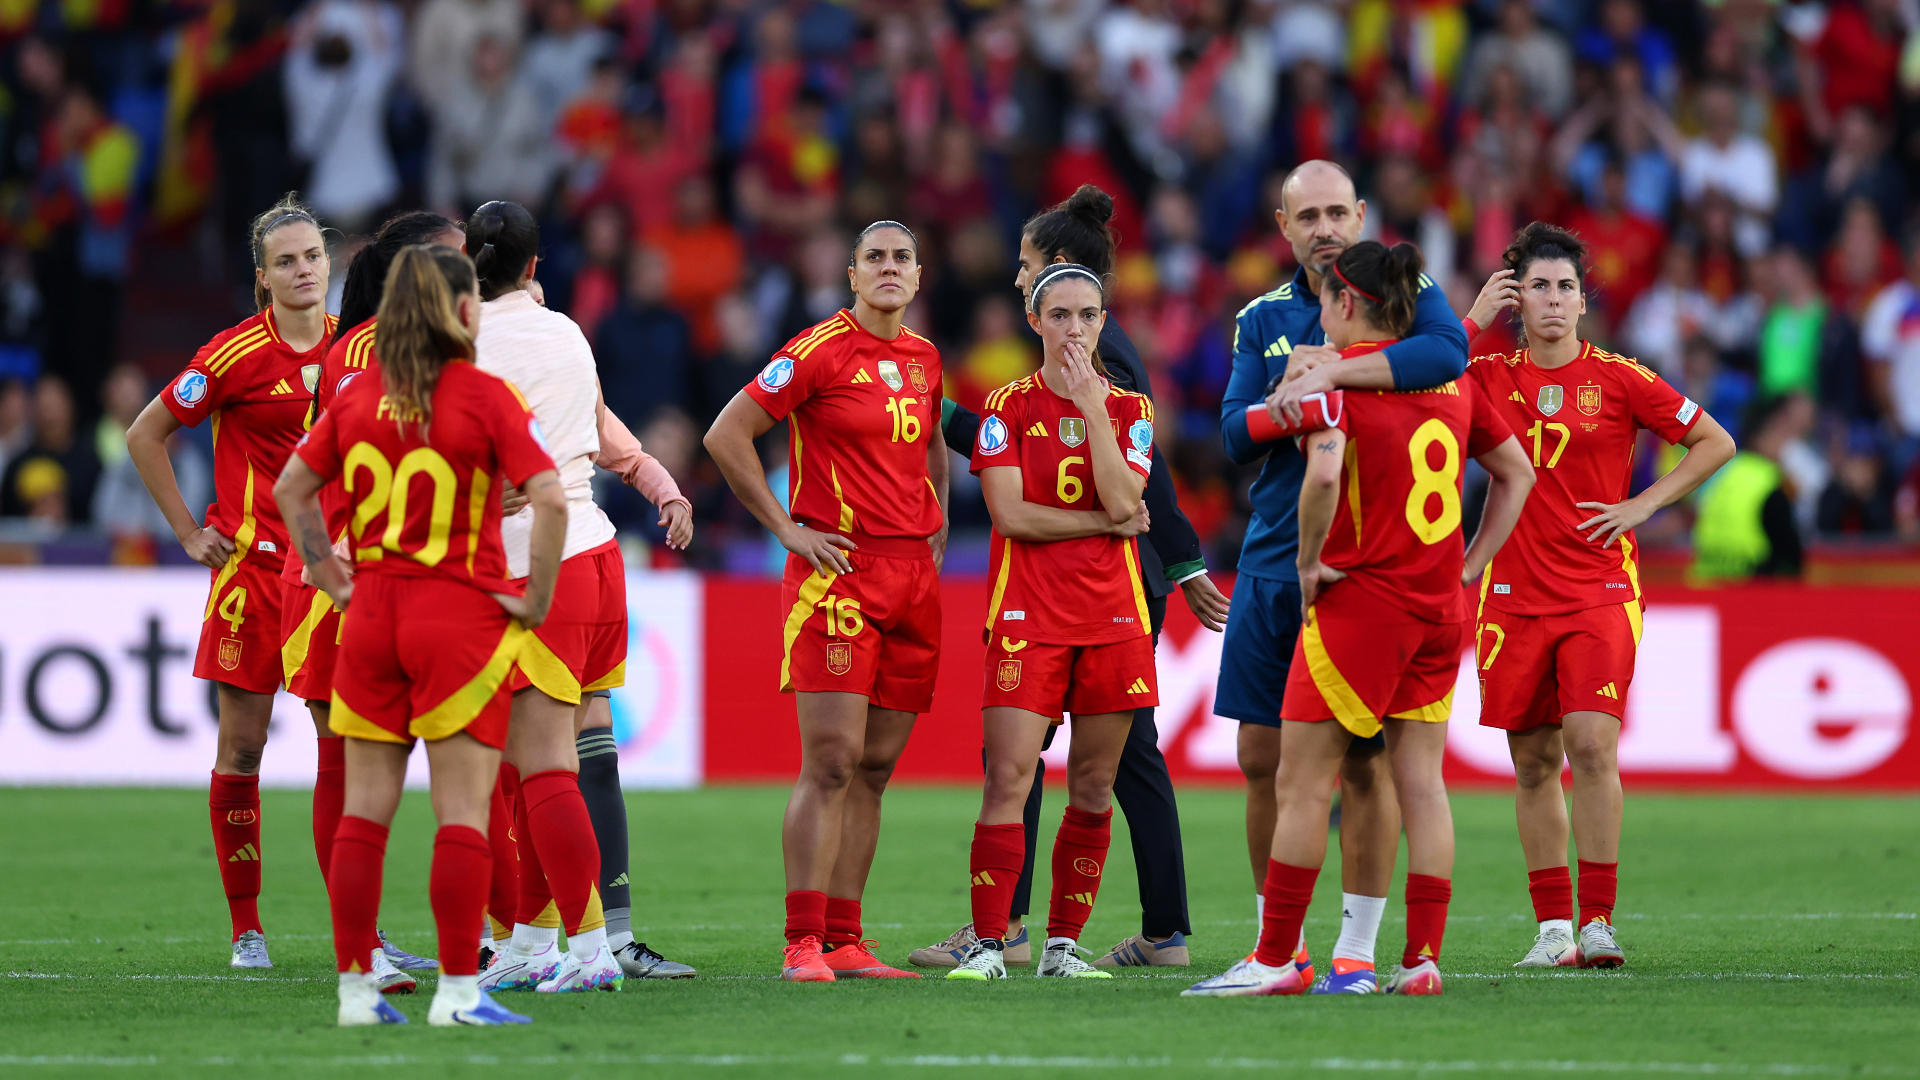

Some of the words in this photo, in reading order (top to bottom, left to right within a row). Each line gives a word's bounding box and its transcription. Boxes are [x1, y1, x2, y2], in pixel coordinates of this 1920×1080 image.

[885, 396, 921, 443] 16
[1526, 420, 1571, 469] 17
[343, 440, 458, 568] 20
[1056, 456, 1085, 504] 6
[1405, 417, 1462, 545] 8
[218, 585, 247, 634] 4
[817, 594, 865, 637] 16
[1476, 622, 1506, 671] 17
